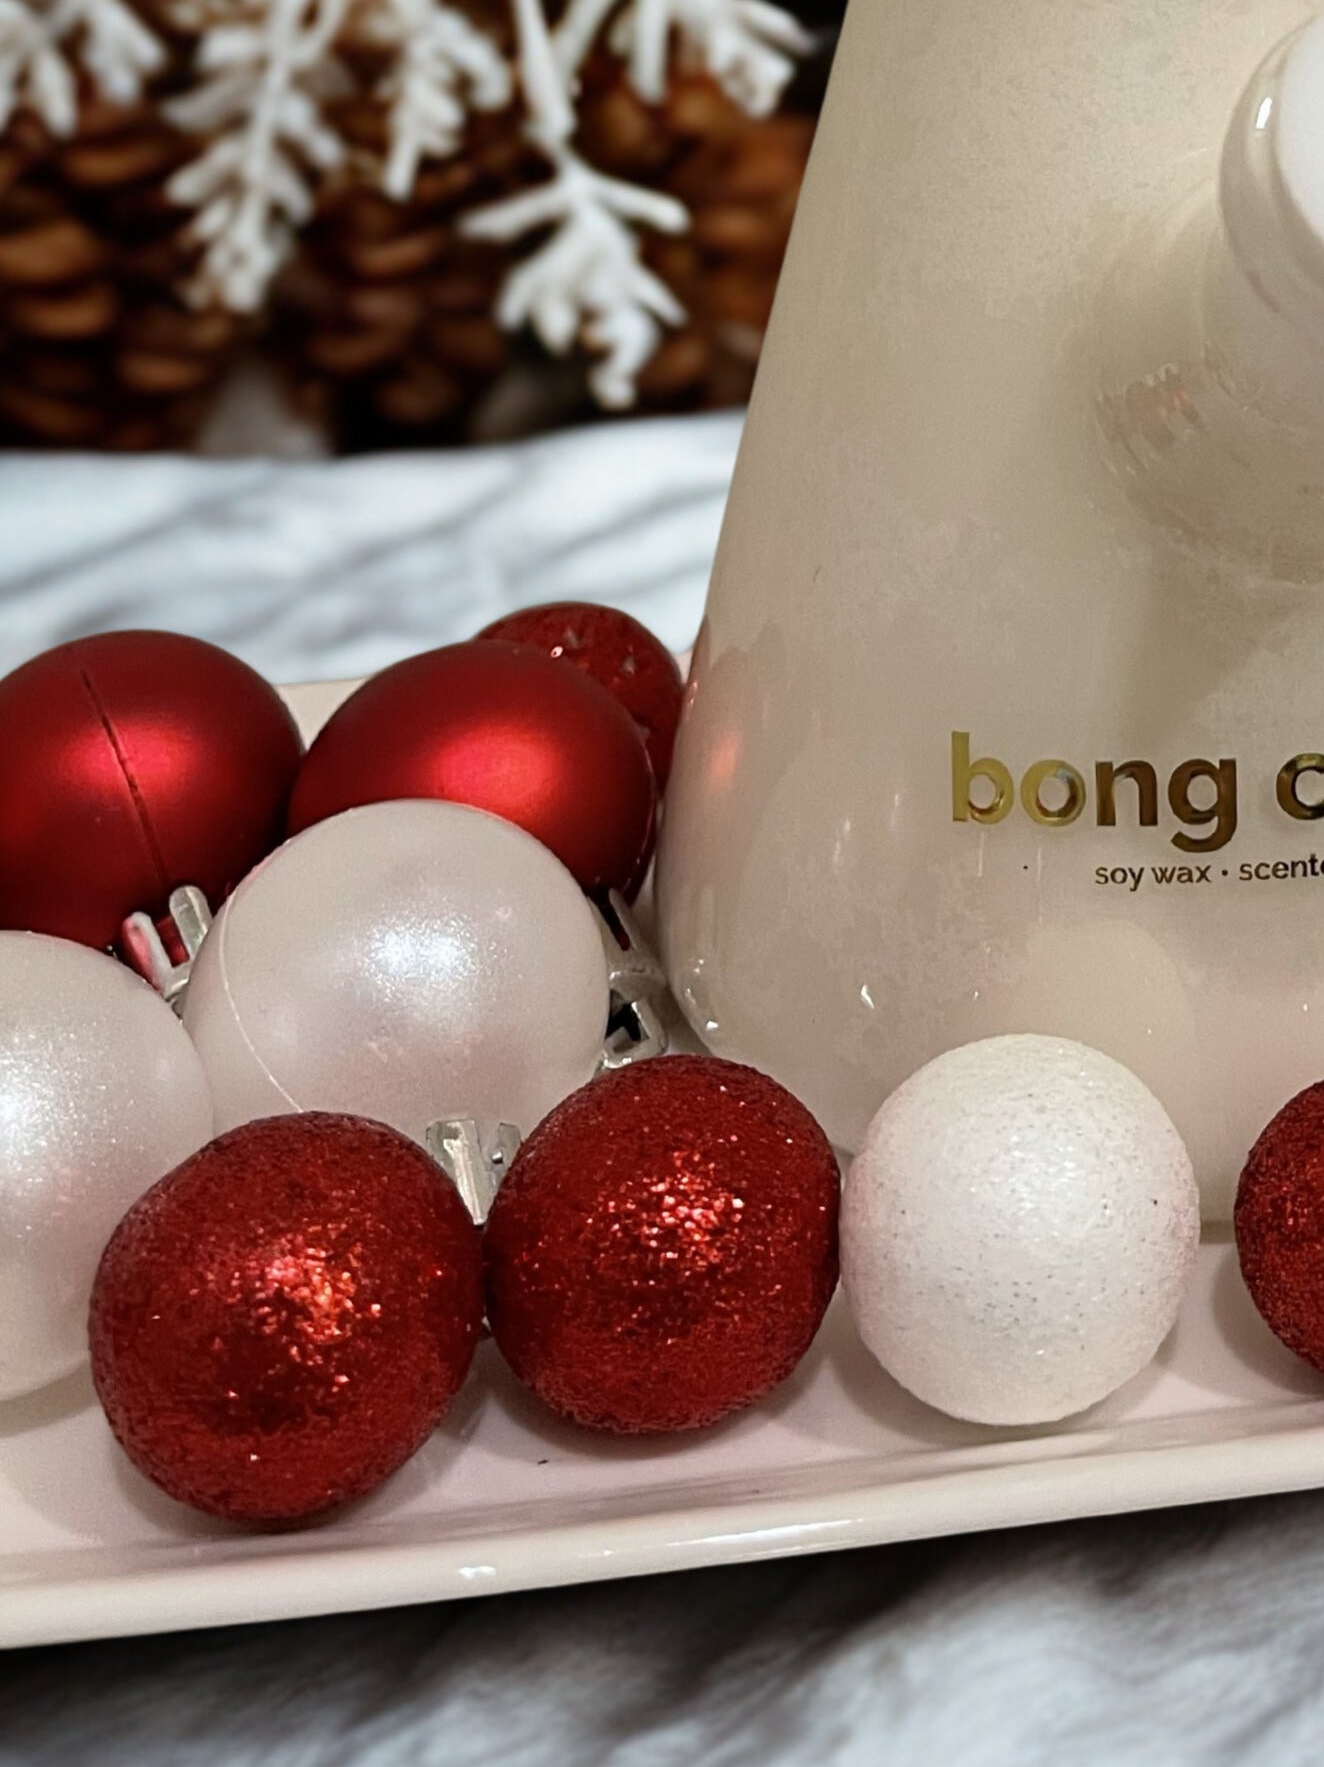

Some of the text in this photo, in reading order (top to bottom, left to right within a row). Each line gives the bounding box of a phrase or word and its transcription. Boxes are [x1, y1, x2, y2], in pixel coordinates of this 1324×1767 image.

[951, 730, 1238, 854] bong
[1095, 865, 1145, 892] soy
[1151, 865, 1211, 885] wax
